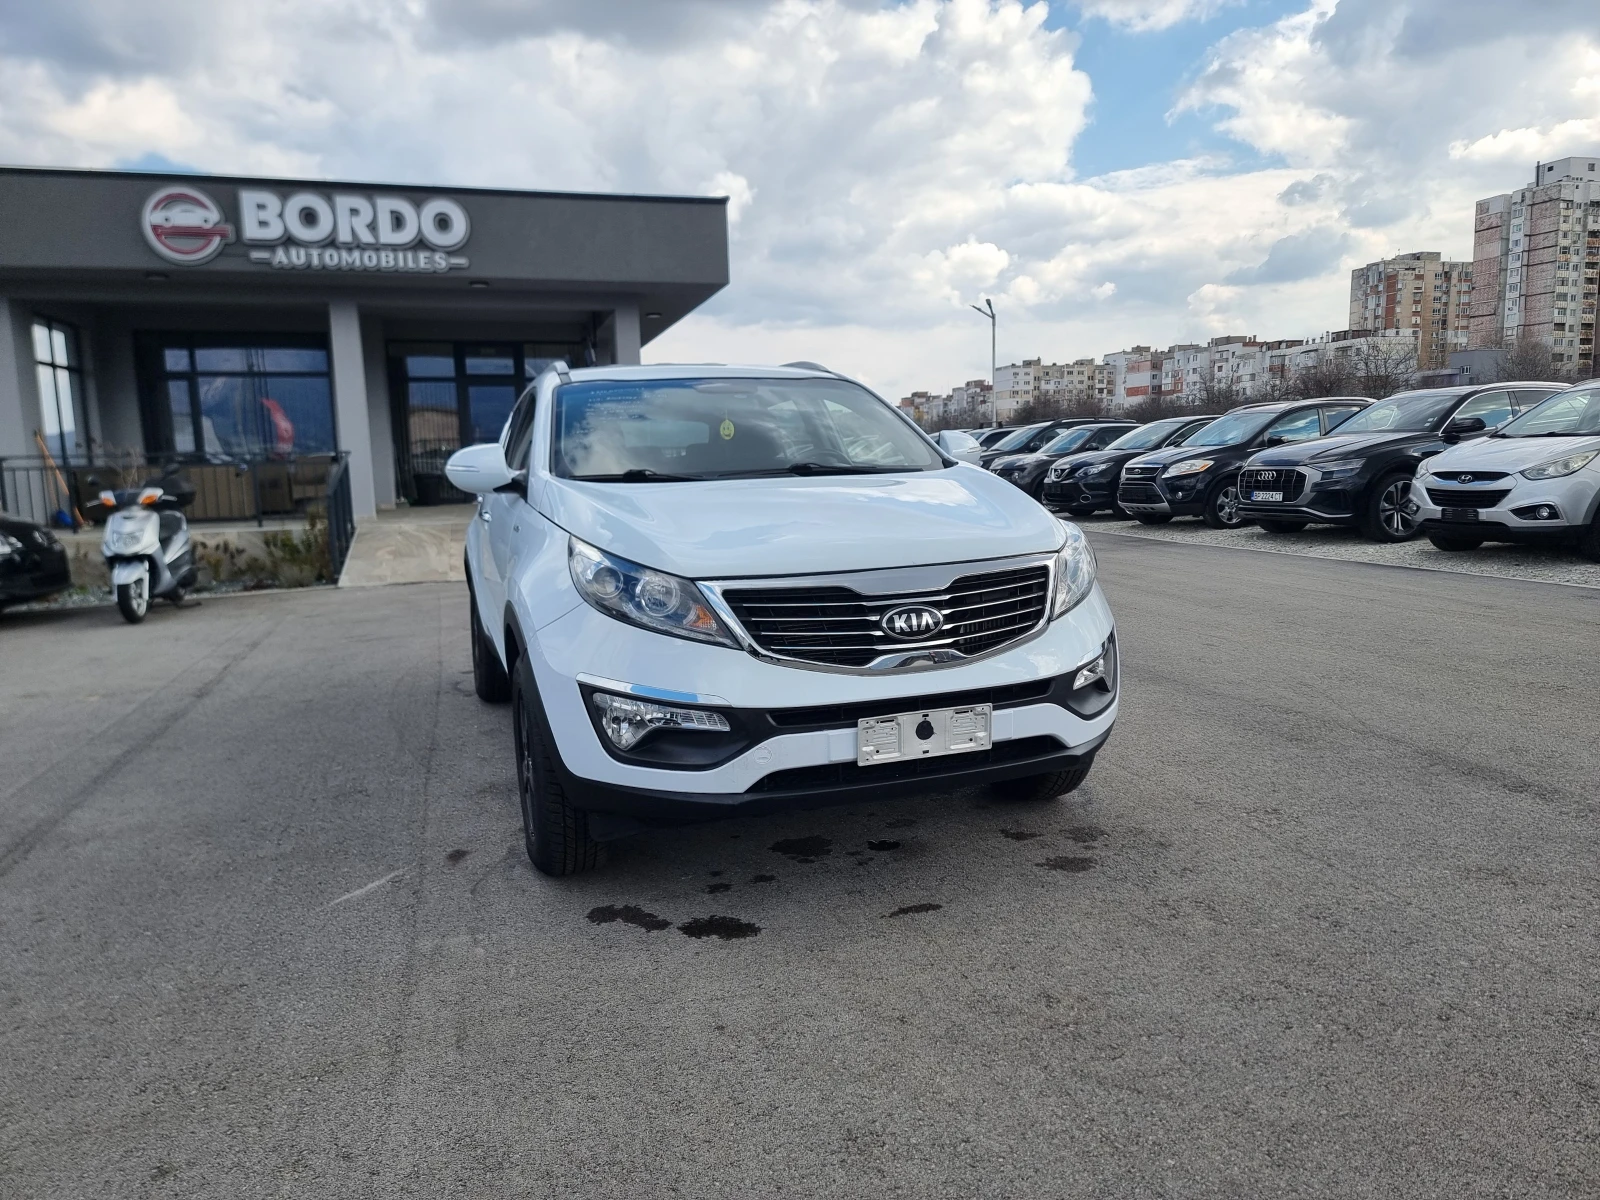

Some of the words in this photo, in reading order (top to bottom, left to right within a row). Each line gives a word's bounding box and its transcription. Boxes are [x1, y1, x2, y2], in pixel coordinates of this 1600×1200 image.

[239, 189, 468, 248] BORDO
[273, 248, 449, 270] AUTOMOBILES
[892, 612, 936, 633] KIA
